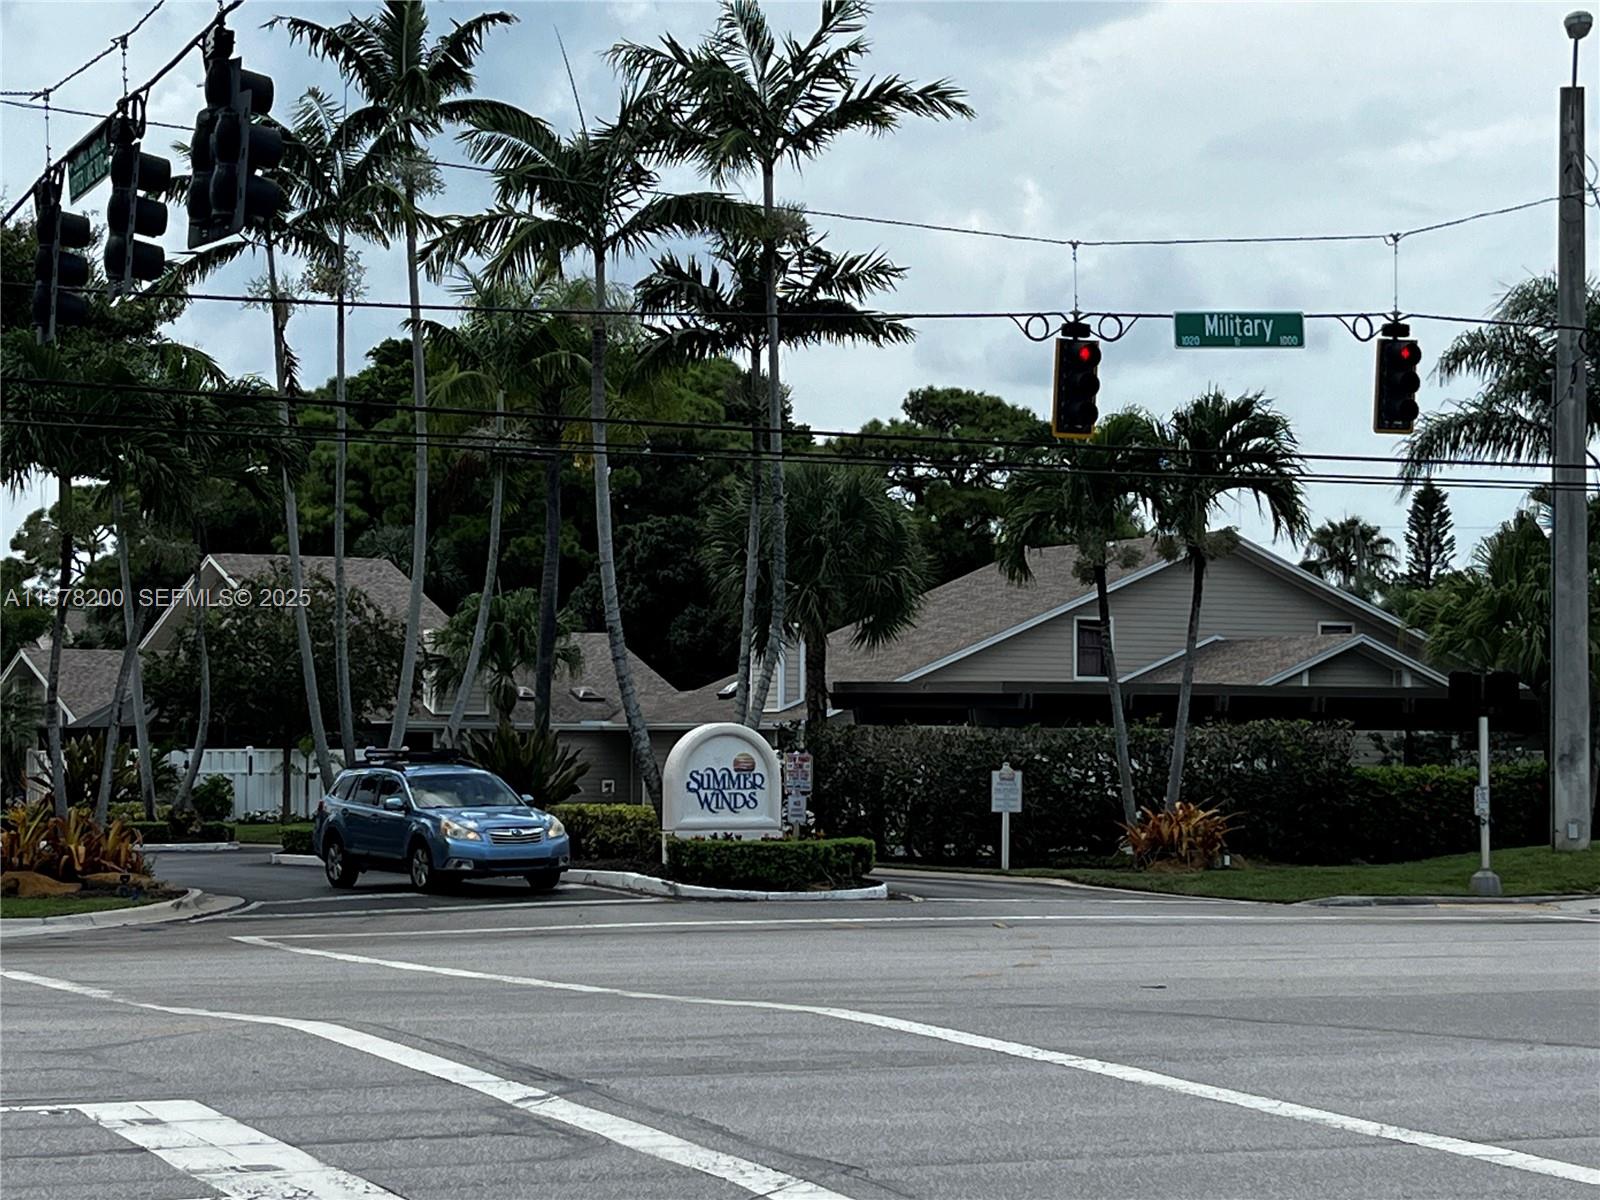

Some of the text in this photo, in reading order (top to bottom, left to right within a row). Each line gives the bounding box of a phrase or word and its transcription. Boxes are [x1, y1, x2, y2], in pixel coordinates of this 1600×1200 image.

[1204, 314, 1274, 342] Military
[686, 767, 765, 793] SUMMER
[695, 789, 759, 813] WINDS
